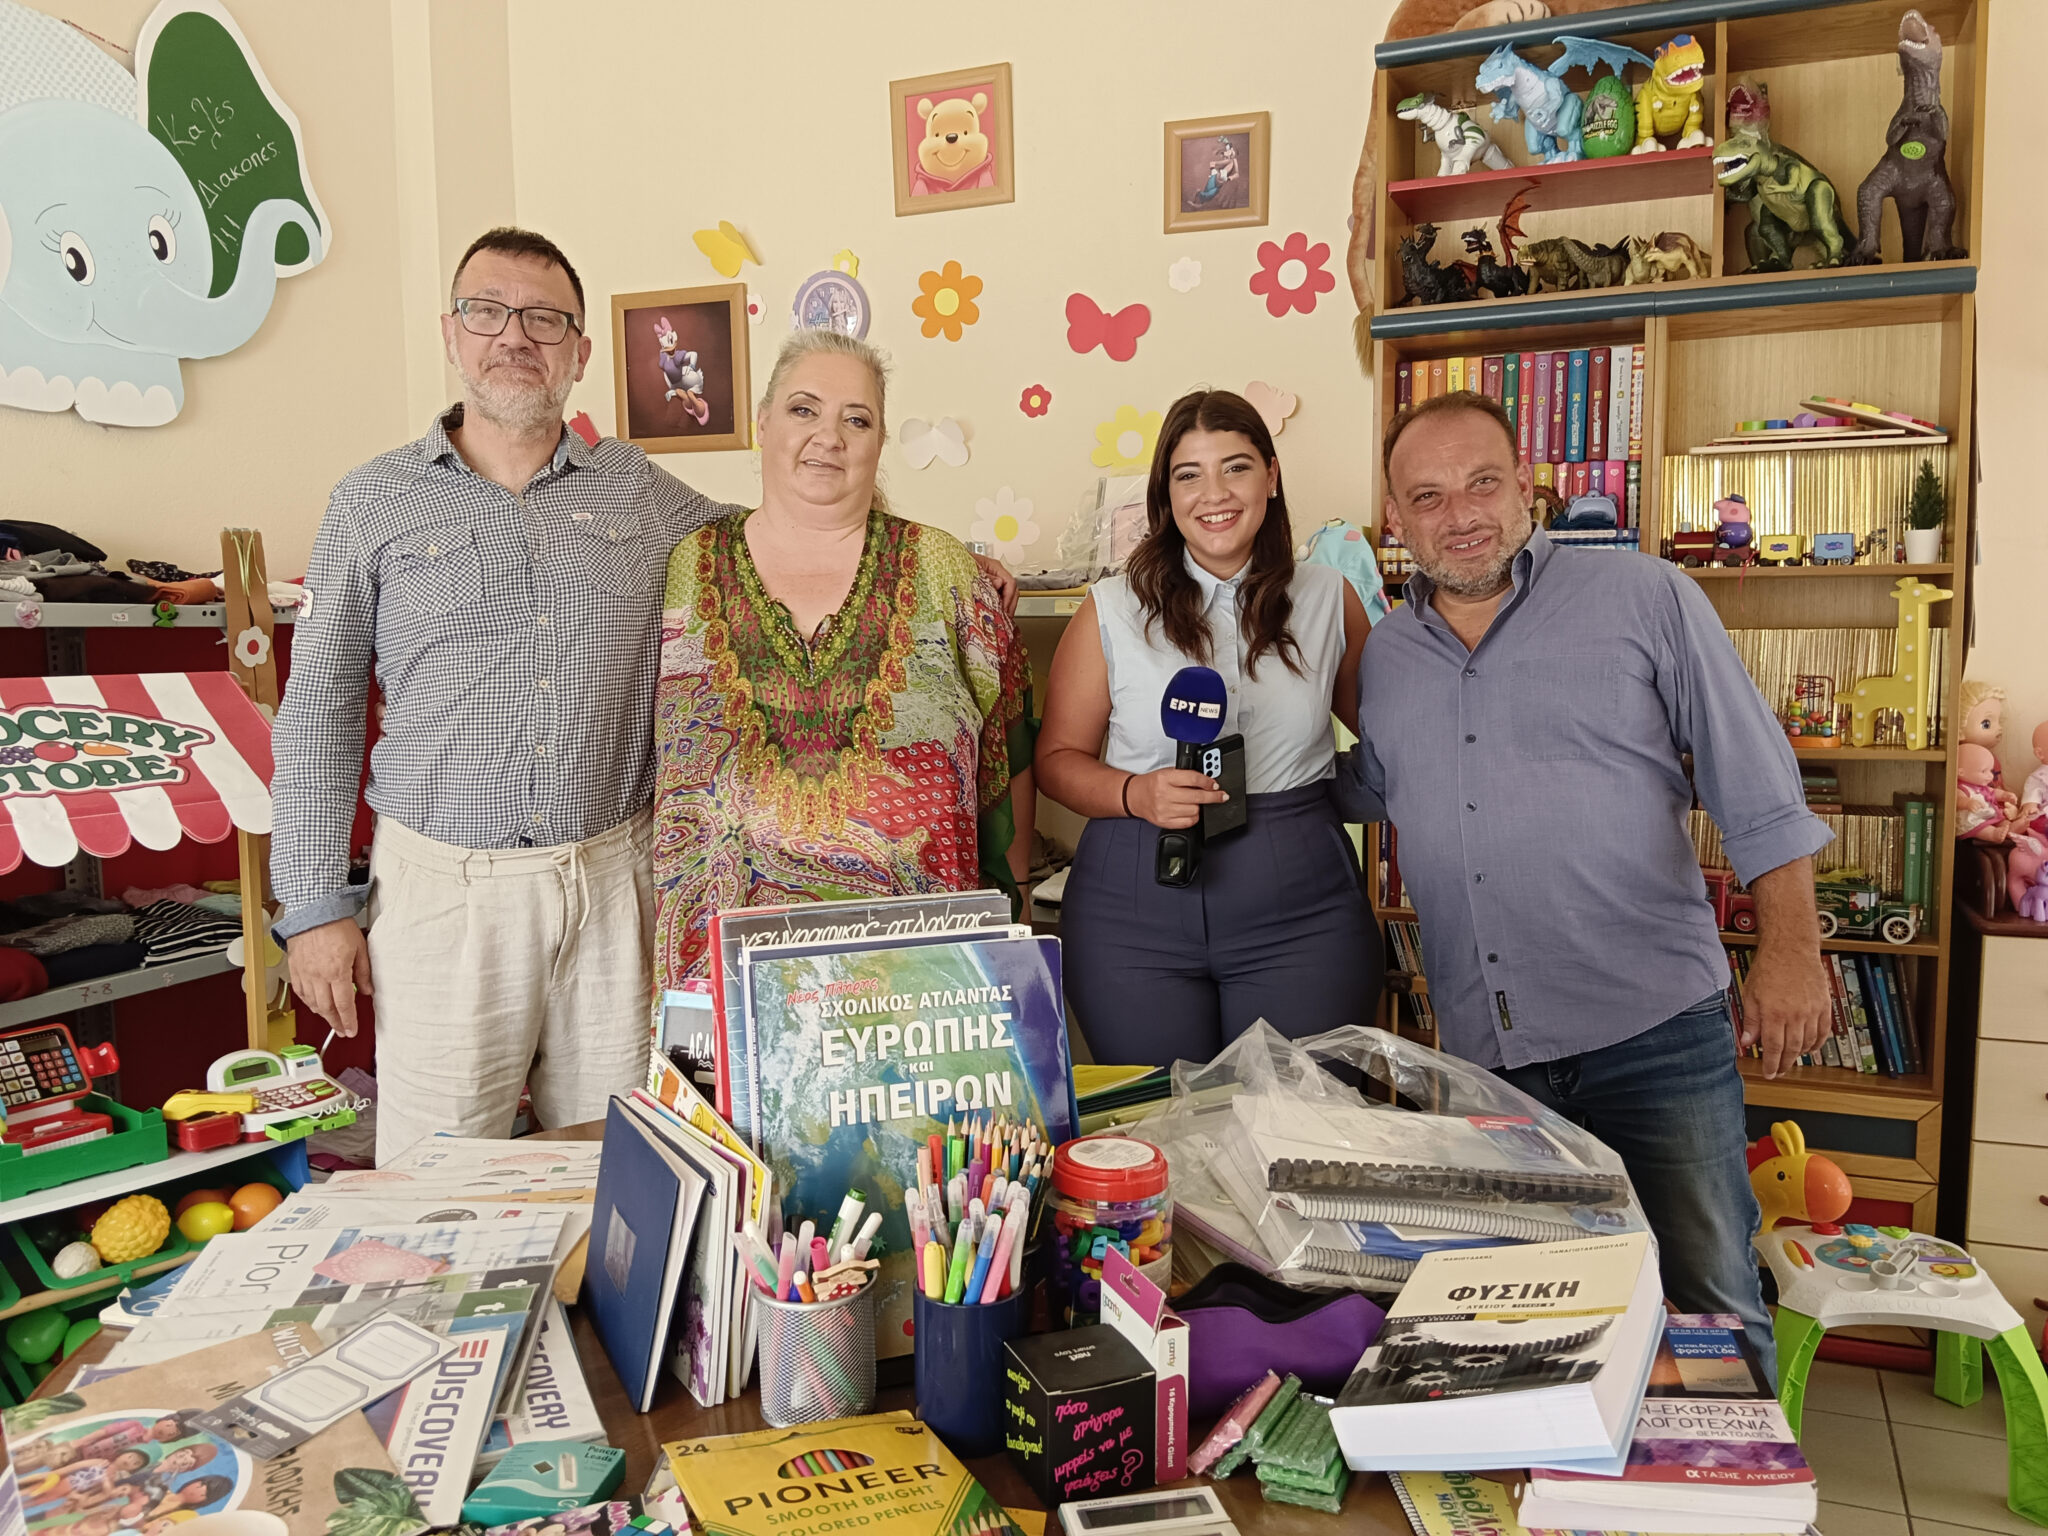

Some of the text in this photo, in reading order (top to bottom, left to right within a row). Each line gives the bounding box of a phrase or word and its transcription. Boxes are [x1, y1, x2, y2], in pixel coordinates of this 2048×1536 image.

[1169, 697, 1219, 715] ΕΡΤ NEWS
[786, 977, 879, 1006] Νέος Πλήρης
[819, 984, 1013, 1018] ΣΧΟΛΙΚΟΣ ΑΤΛΑΝΤΑΣ
[821, 1012, 1014, 1067] ΕΥΡΩΠΗΣ
[908, 1061, 934, 1074] και
[829, 1071, 1012, 1128] ΗΠΕΙΡΩΝ
[1447, 1280, 1581, 1302] ΦΥΣΙΚΗ
[1167, 1387, 1176, 1468] 16 Κηρομπογιές Giant
[1636, 1417, 1775, 1431] ΛΟΓΟΤΕΧΝΙΑ
[1696, 1430, 1779, 1439] ΘΕΜΑΤΟΛΟΓΙΑ
[587, 1445, 618, 1456] Pencil
[676, 1443, 710, 1457] 24
[1099, 1438, 1115, 1453] να
[1119, 1426, 1133, 1447] με
[584, 1452, 613, 1463] Leads
[1746, 1472, 1797, 1480] ΛΥΚΕΙΟΥ
[724, 1463, 948, 1516] PIONEER
[766, 1484, 935, 1526] SMOOTH BRIGHT
[874, 1499, 946, 1522] PENCILS
